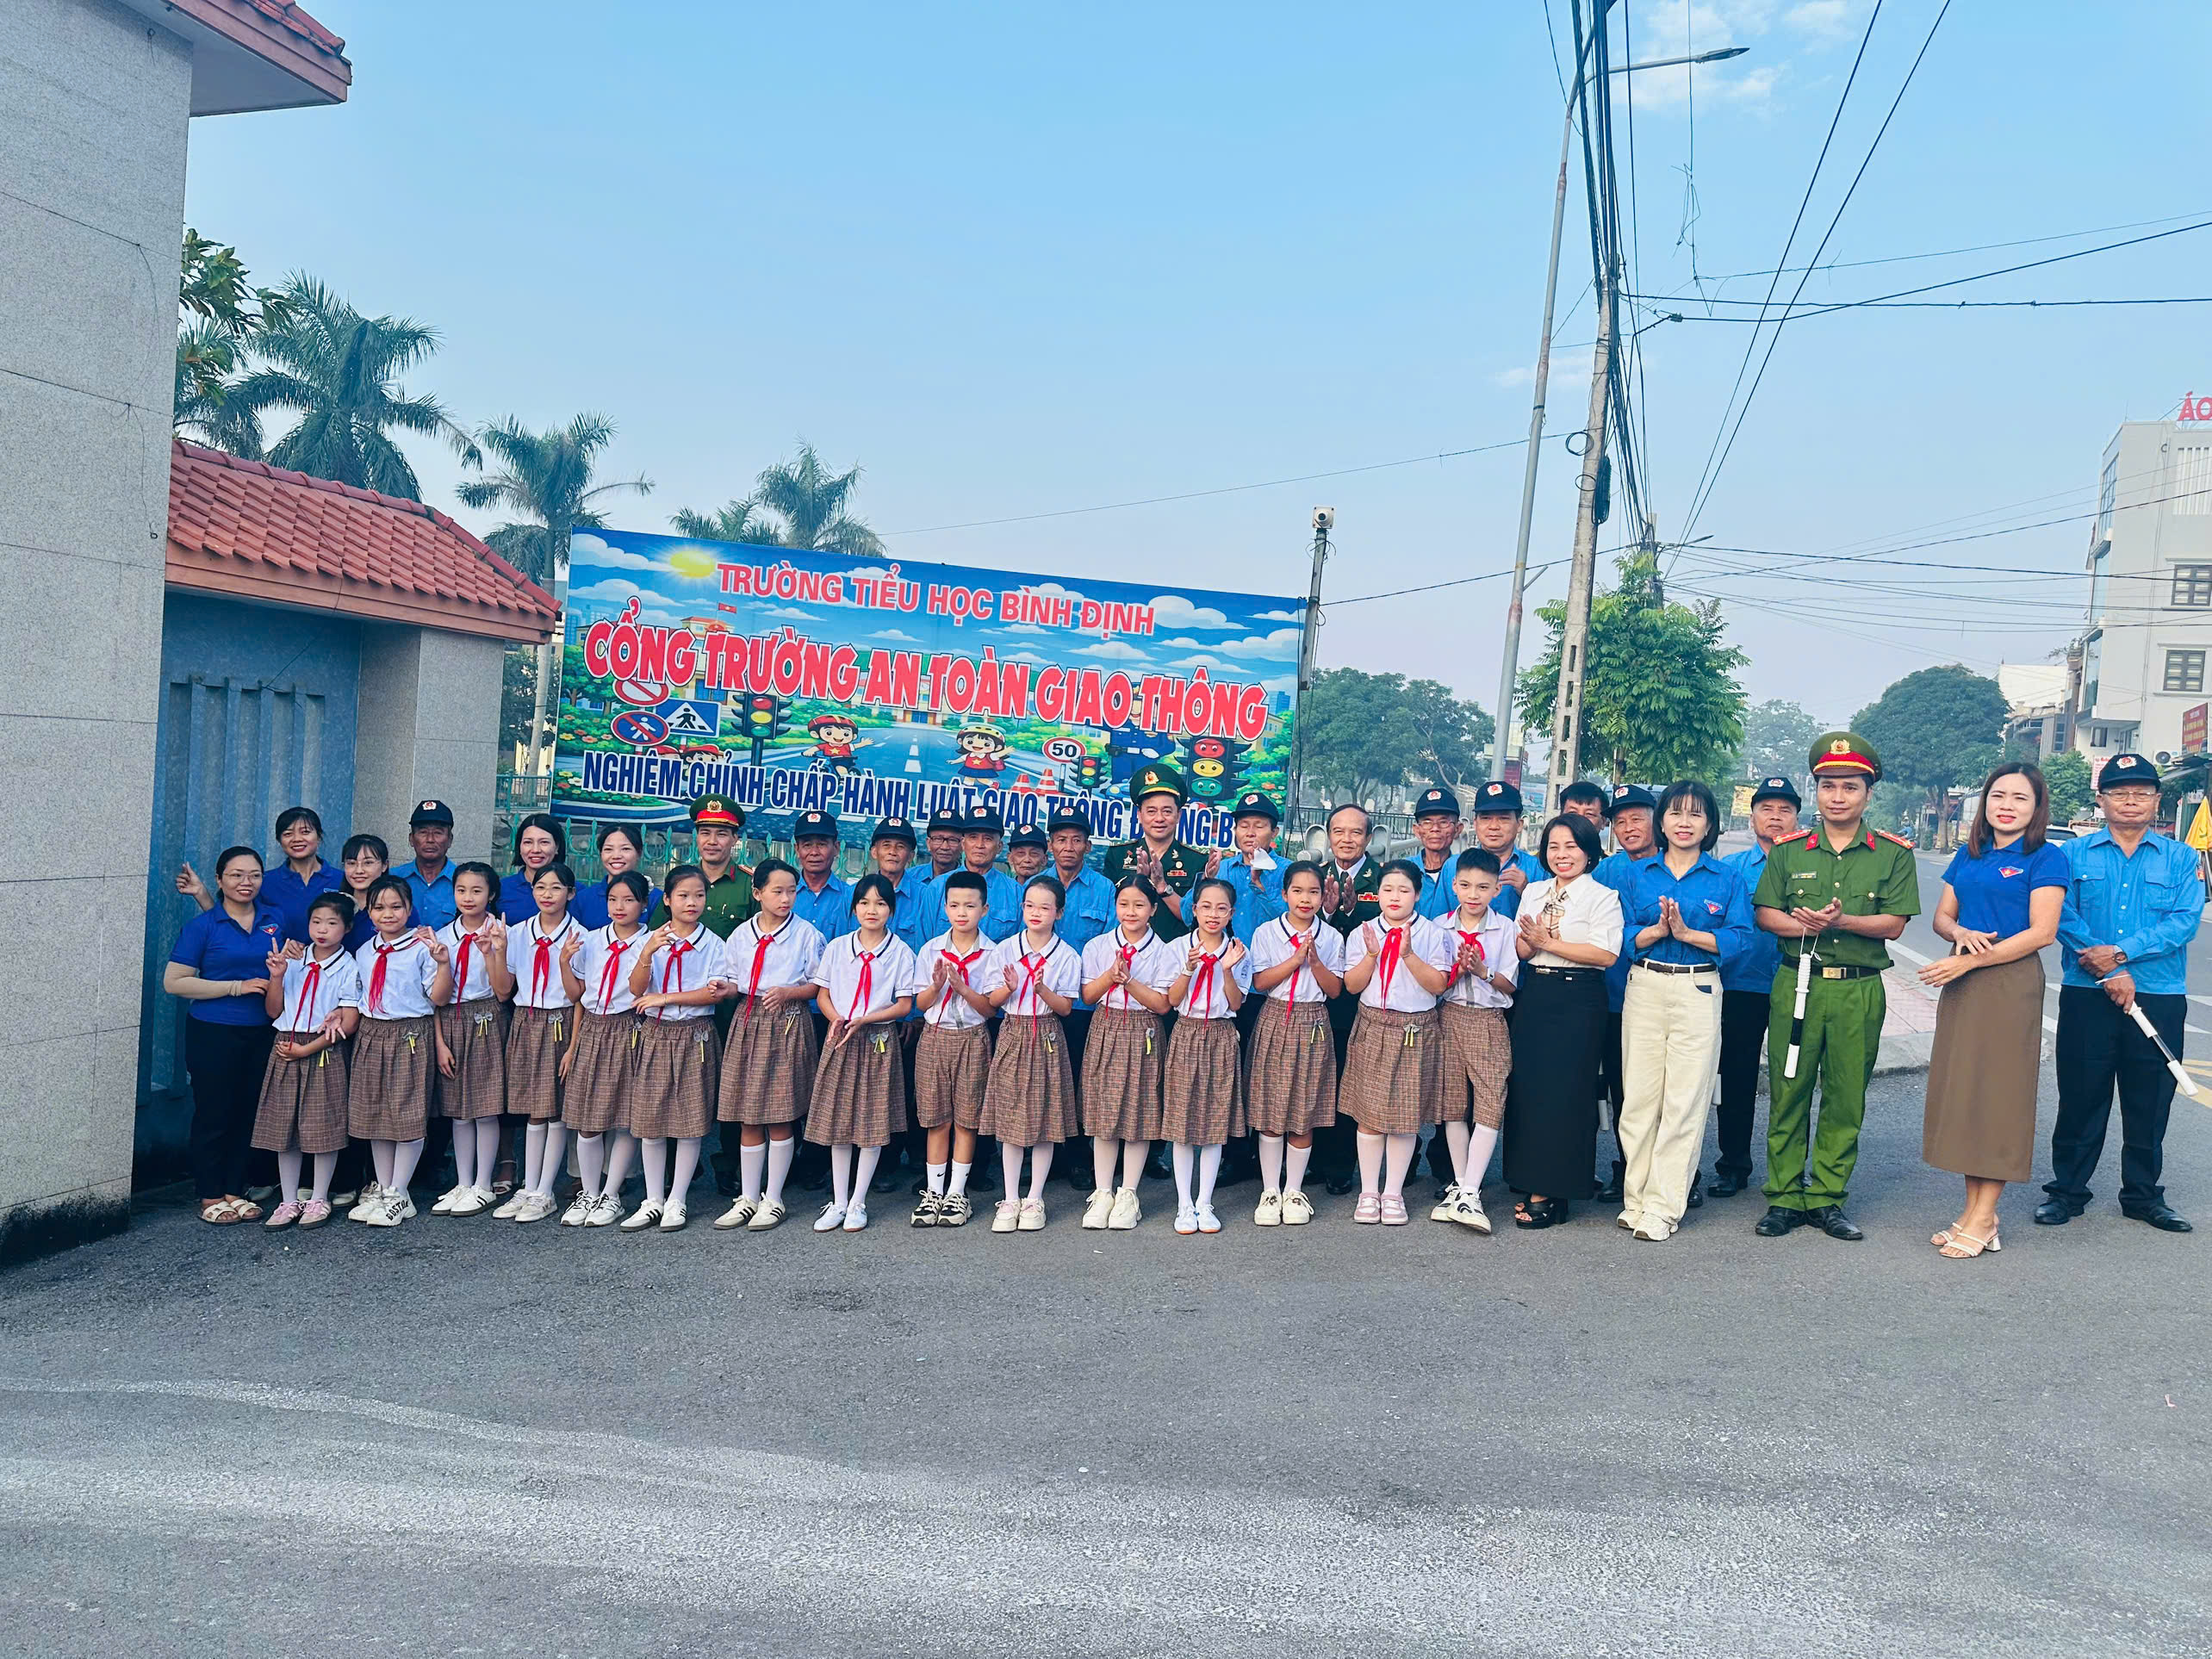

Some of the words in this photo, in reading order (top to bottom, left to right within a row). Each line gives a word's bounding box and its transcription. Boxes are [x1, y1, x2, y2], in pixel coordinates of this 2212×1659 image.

[717, 562, 842, 603] TRƯỜNG
[853, 564, 920, 612] TIỂU
[928, 586, 992, 626] HỌC
[1001, 587, 1072, 627] BÌNH
[1080, 600, 1155, 638] ĐỊNH
[585, 598, 697, 686] CỔNG
[704, 626, 860, 702] TRƯỜNG
[862, 650, 922, 709] AN
[928, 646, 1031, 719] TOÀN
[1035, 665, 1133, 729] GIAO
[1139, 667, 1269, 741] THÔNG
[1052, 743, 1078, 758] 50
[582, 749, 683, 798] NGHIÊM
[689, 750, 766, 805] CHỈNH
[771, 760, 837, 811] CHẤP
[842, 770, 910, 819] HÀNH
[1129, 805, 1212, 847] ĐNG
